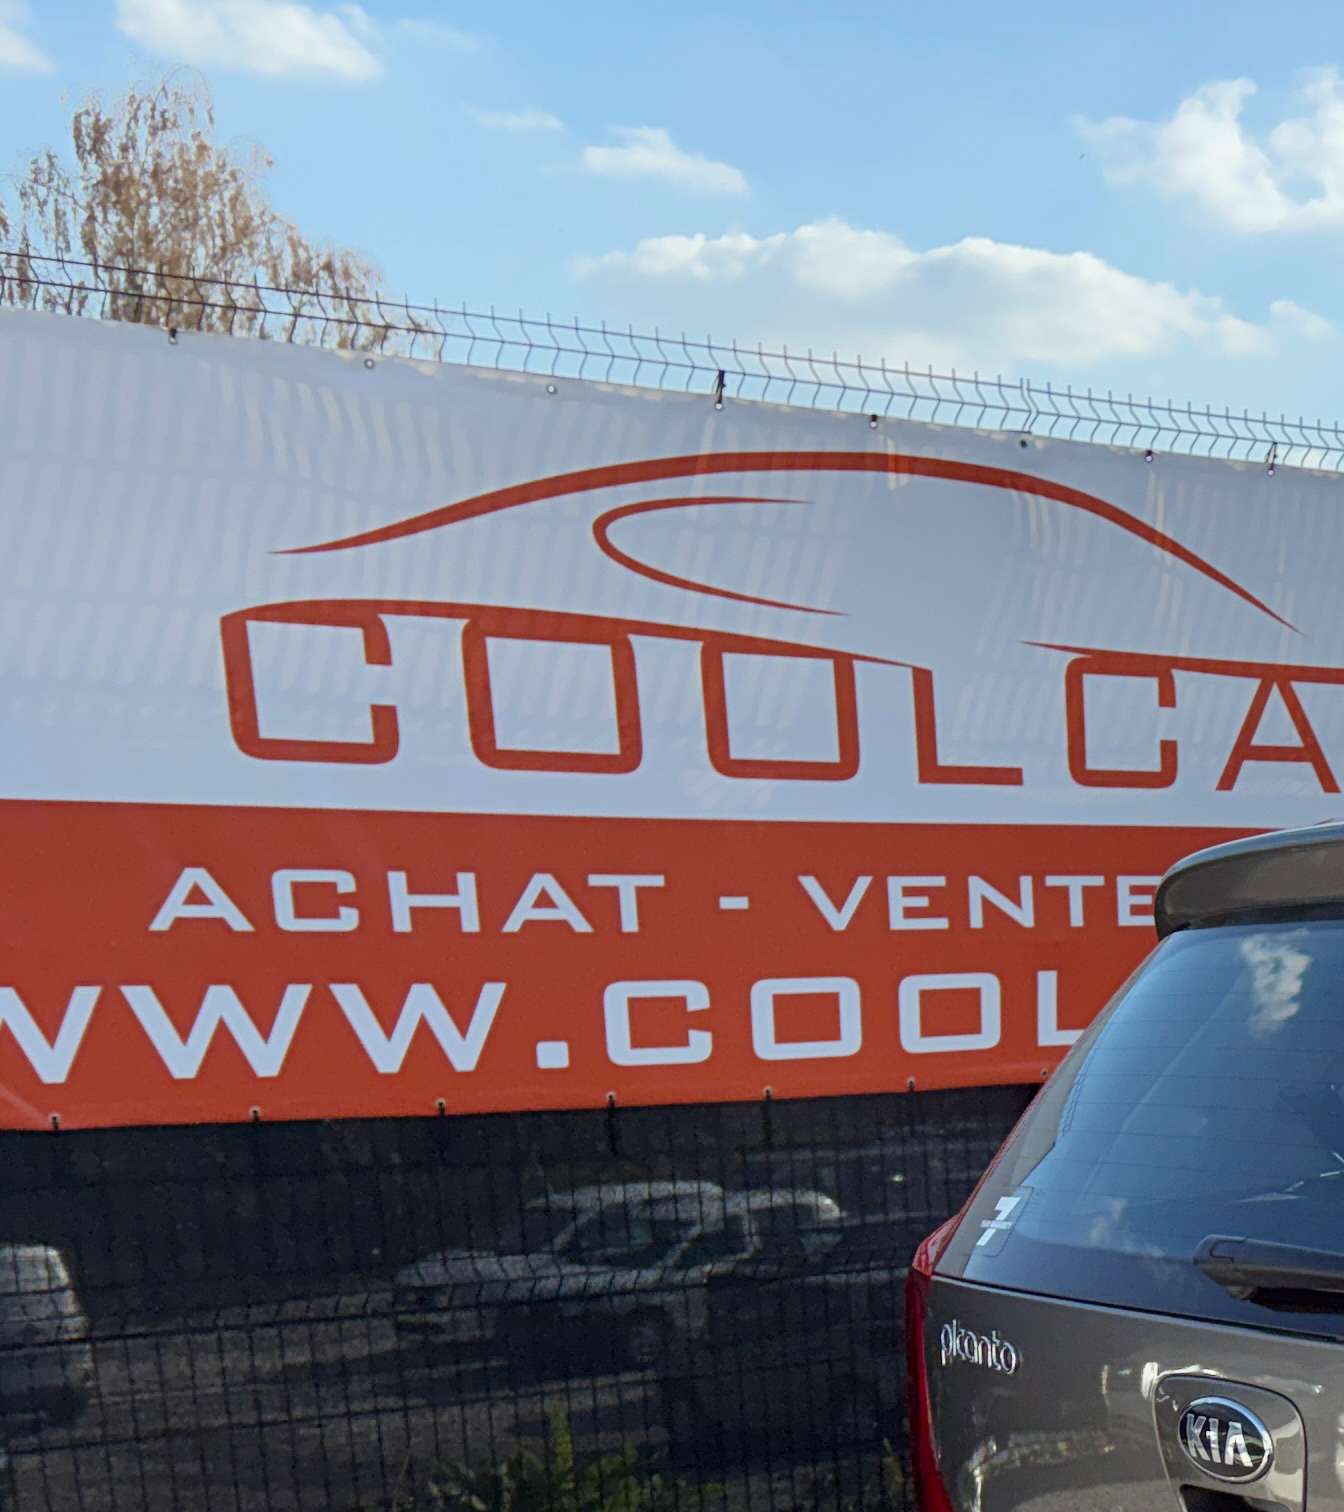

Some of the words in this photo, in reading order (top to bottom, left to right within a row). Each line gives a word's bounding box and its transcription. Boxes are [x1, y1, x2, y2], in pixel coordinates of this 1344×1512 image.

[148, 866, 666, 934] ACHAT
[798, 873, 1163, 932] VENTE
[1186, 1413, 1254, 1468] KIA
